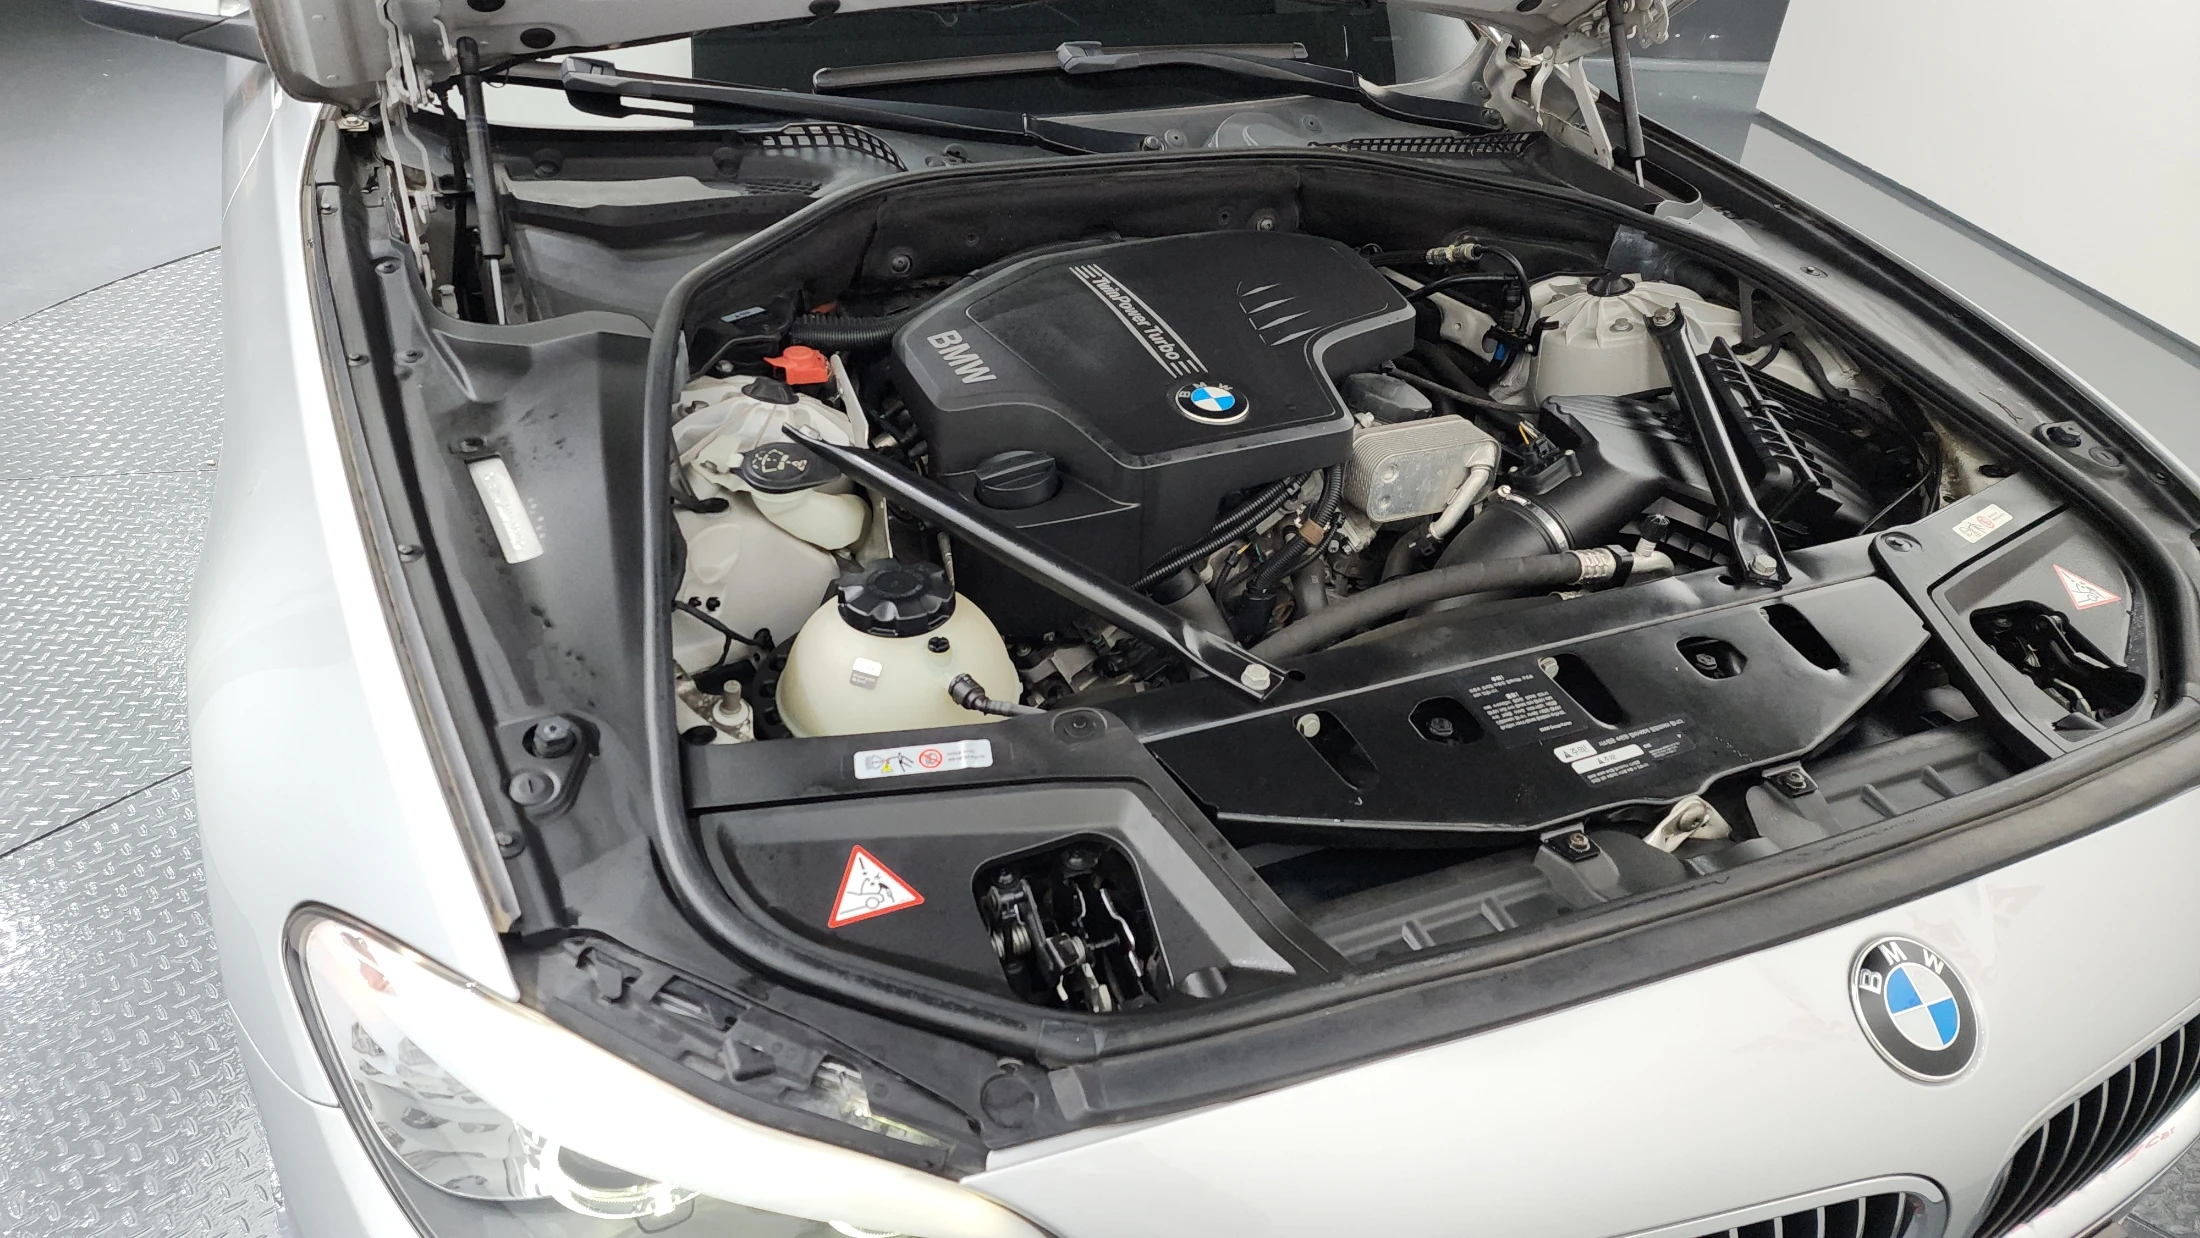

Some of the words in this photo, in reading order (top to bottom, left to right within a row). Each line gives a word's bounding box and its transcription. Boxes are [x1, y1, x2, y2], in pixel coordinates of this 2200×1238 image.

[1092, 276, 1151, 327] TwinPower
[1144, 325, 1180, 361] Turbo
[926, 329, 997, 384] BMW
[1178, 381, 1234, 398] BMW
[1859, 941, 1945, 995] BMW
